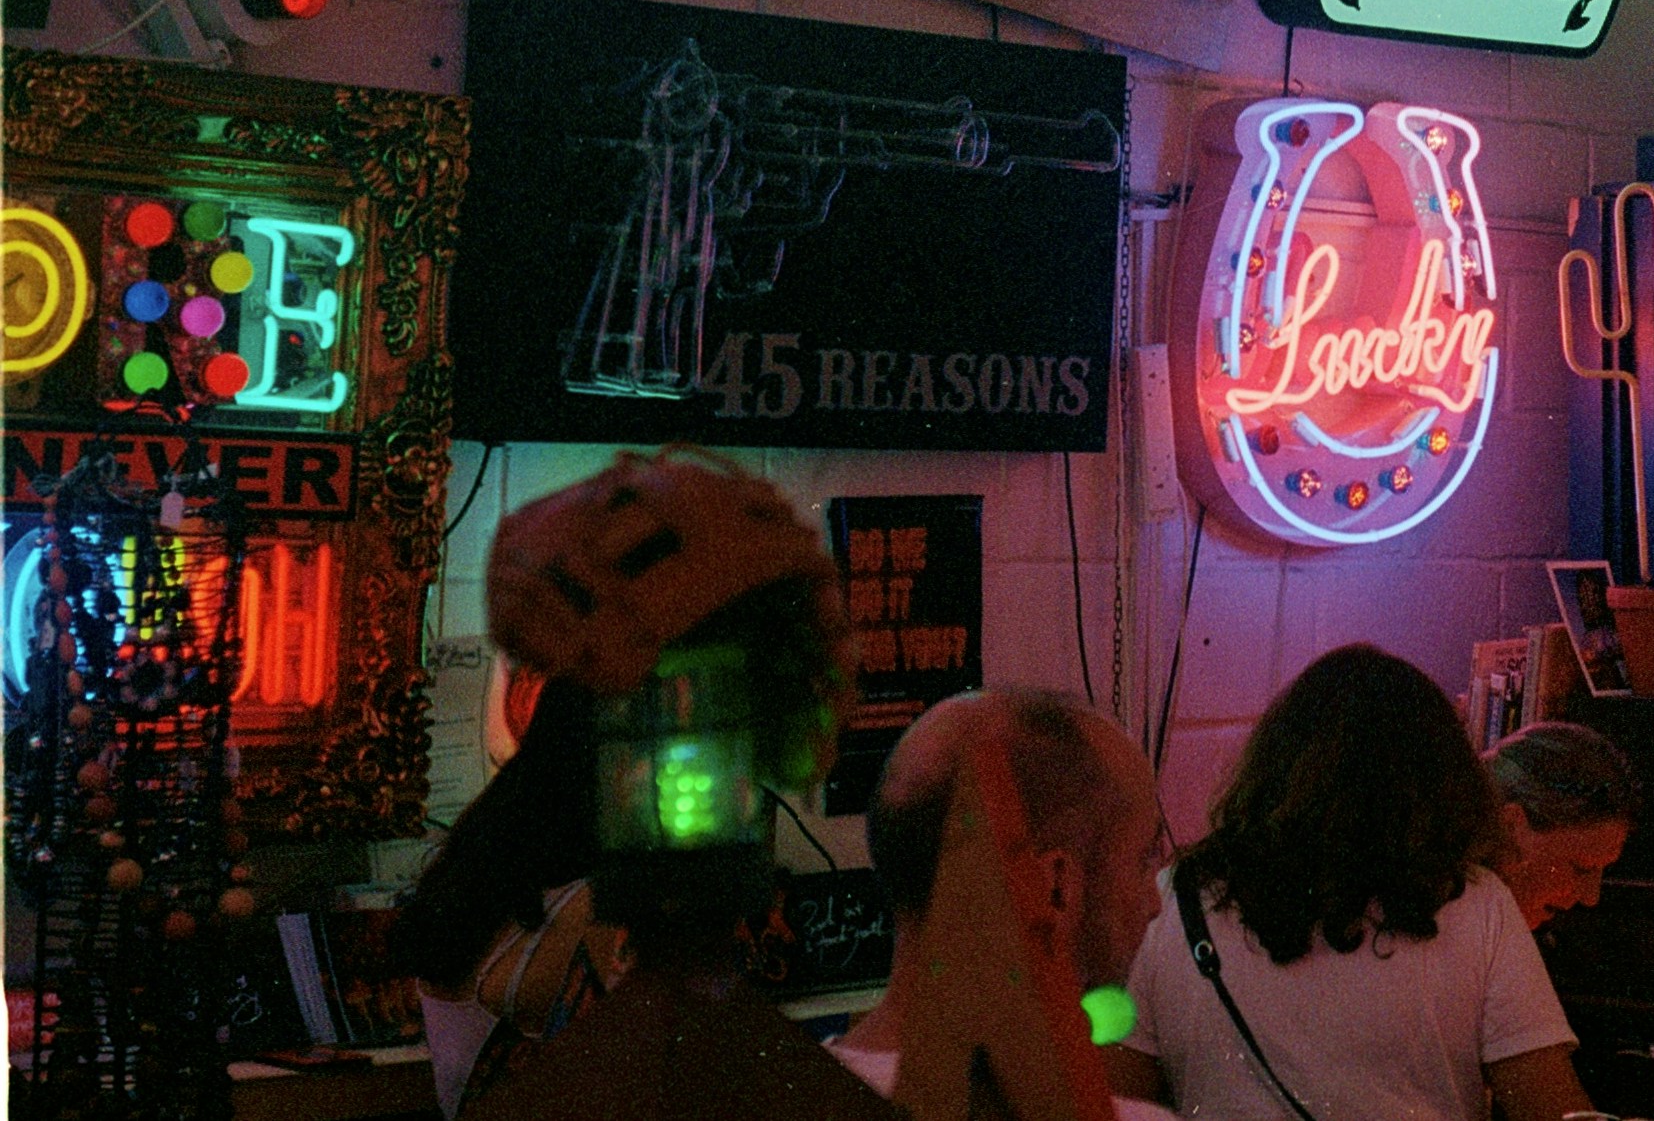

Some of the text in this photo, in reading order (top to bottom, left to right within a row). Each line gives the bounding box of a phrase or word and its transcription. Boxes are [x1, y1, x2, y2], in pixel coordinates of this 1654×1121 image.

[702, 332, 1093, 419] 45 REASONS
[1225, 238, 1495, 415] Lucky
